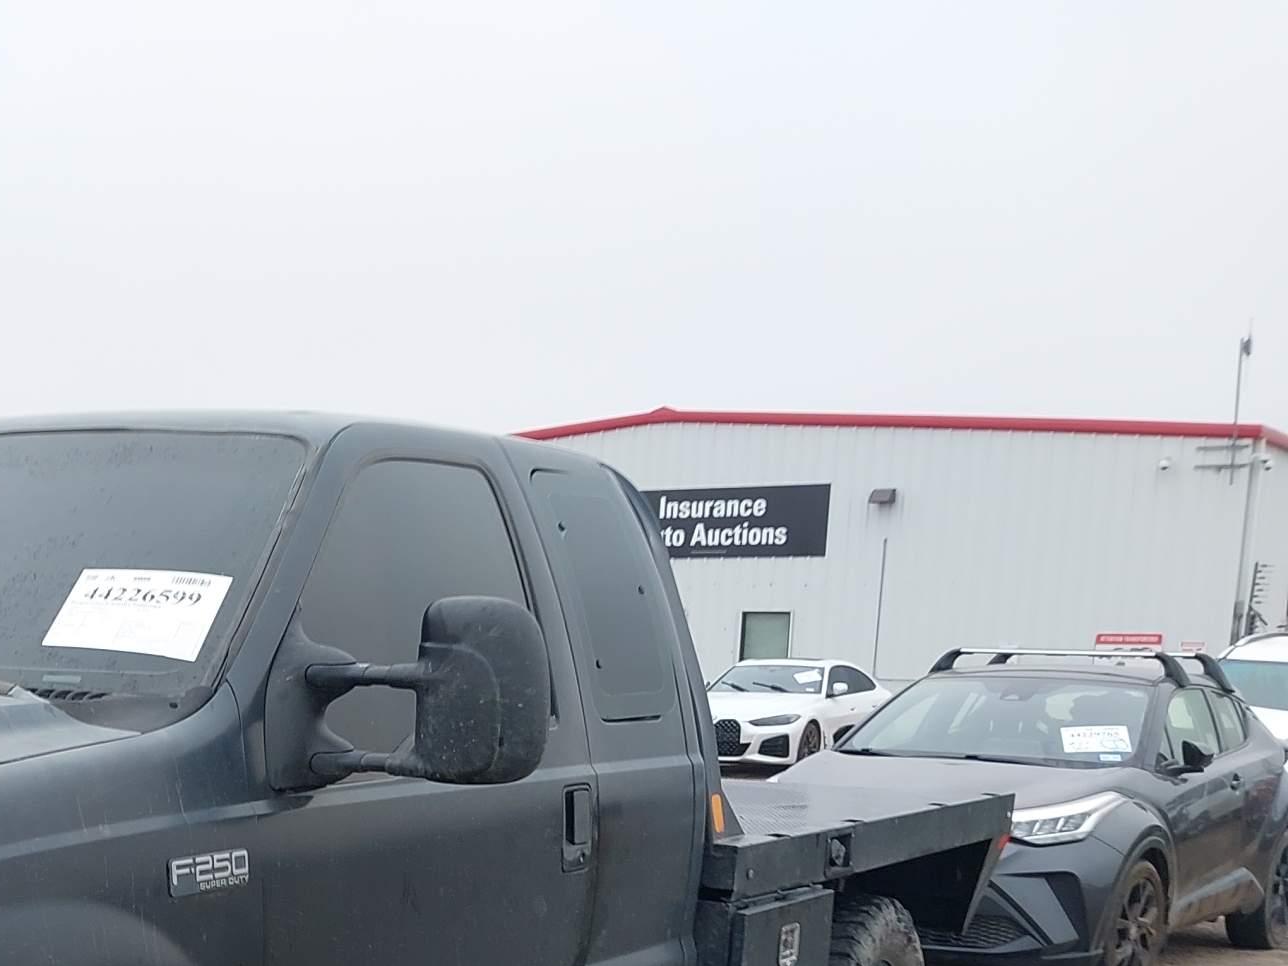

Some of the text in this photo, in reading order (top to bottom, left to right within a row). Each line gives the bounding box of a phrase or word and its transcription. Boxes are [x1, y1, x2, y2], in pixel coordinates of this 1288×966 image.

[659, 496, 767, 519] Insurance
[660, 521, 788, 547] to Auctions
[84, 586, 203, 605] 44226599
